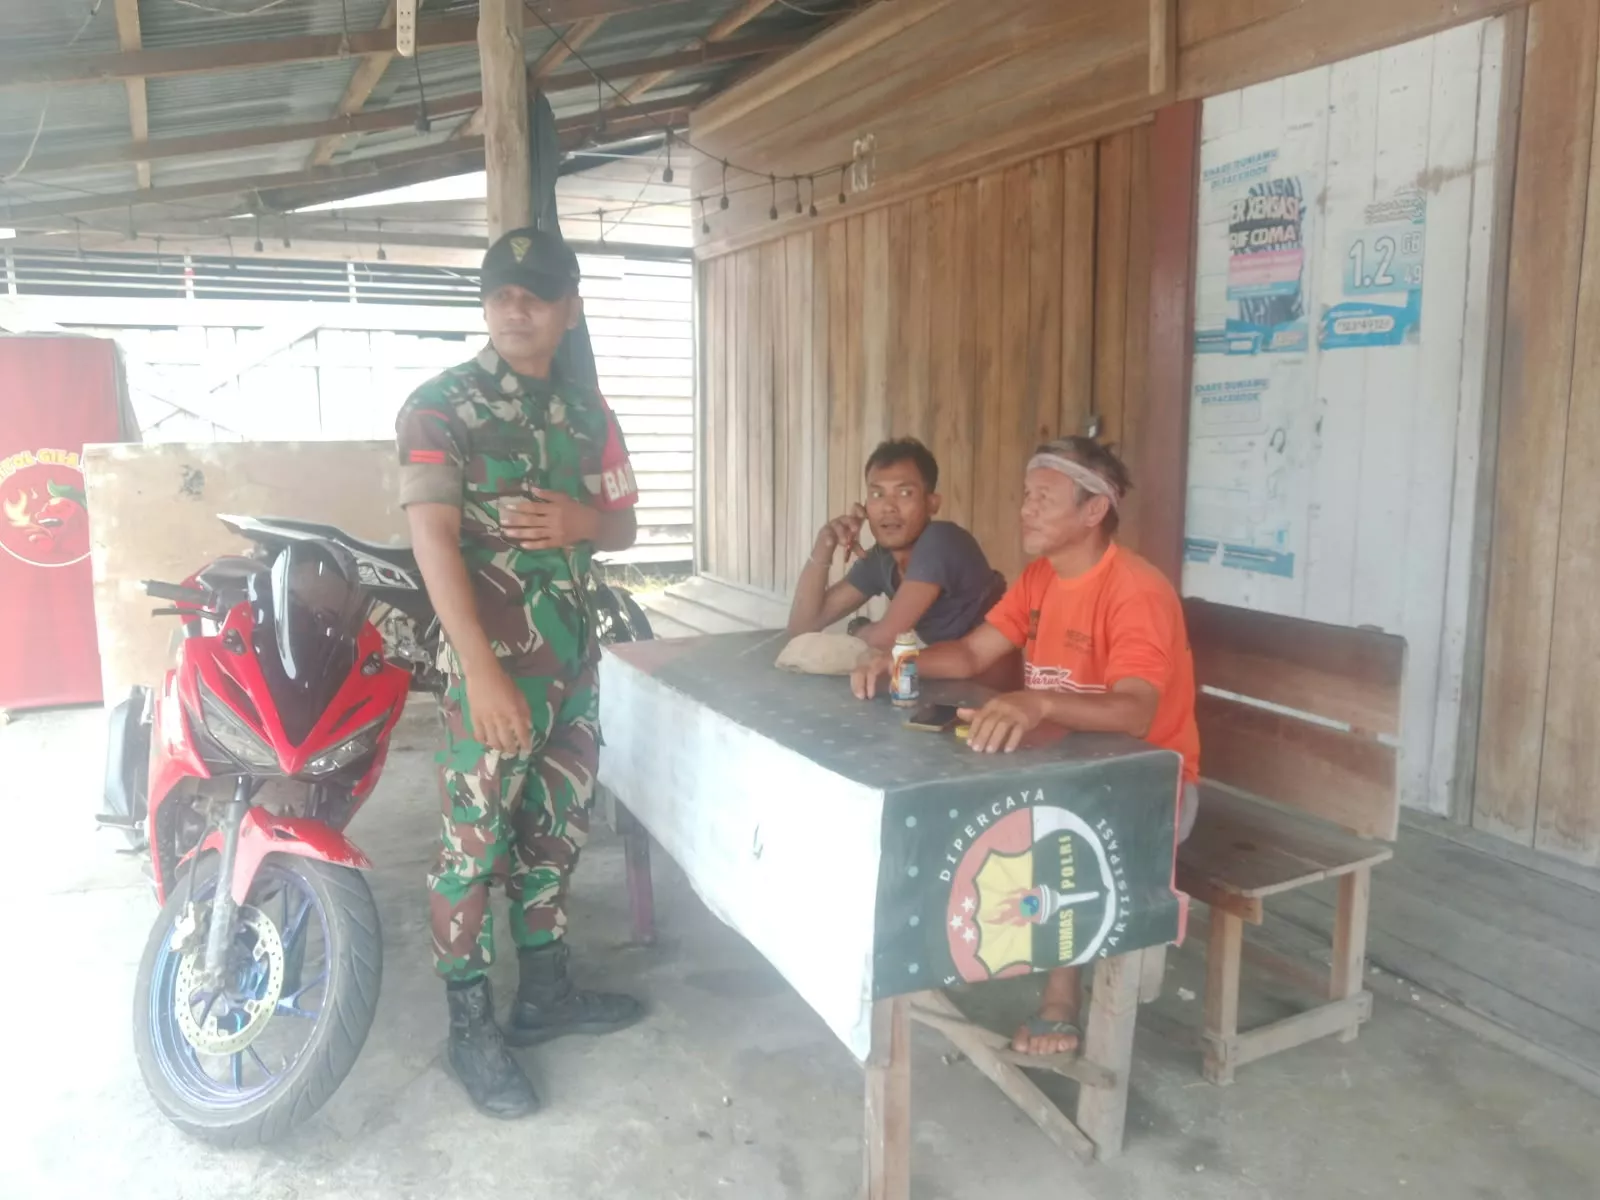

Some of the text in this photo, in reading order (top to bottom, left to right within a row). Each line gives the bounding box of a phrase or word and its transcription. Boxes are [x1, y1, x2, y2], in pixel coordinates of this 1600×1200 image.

[1348, 235, 1396, 288] 1.2
[1402, 231, 1422, 254] GB
[939, 788, 1045, 882] DIPERCAYA
[1058, 835, 1076, 962] HUMAS POLRI
